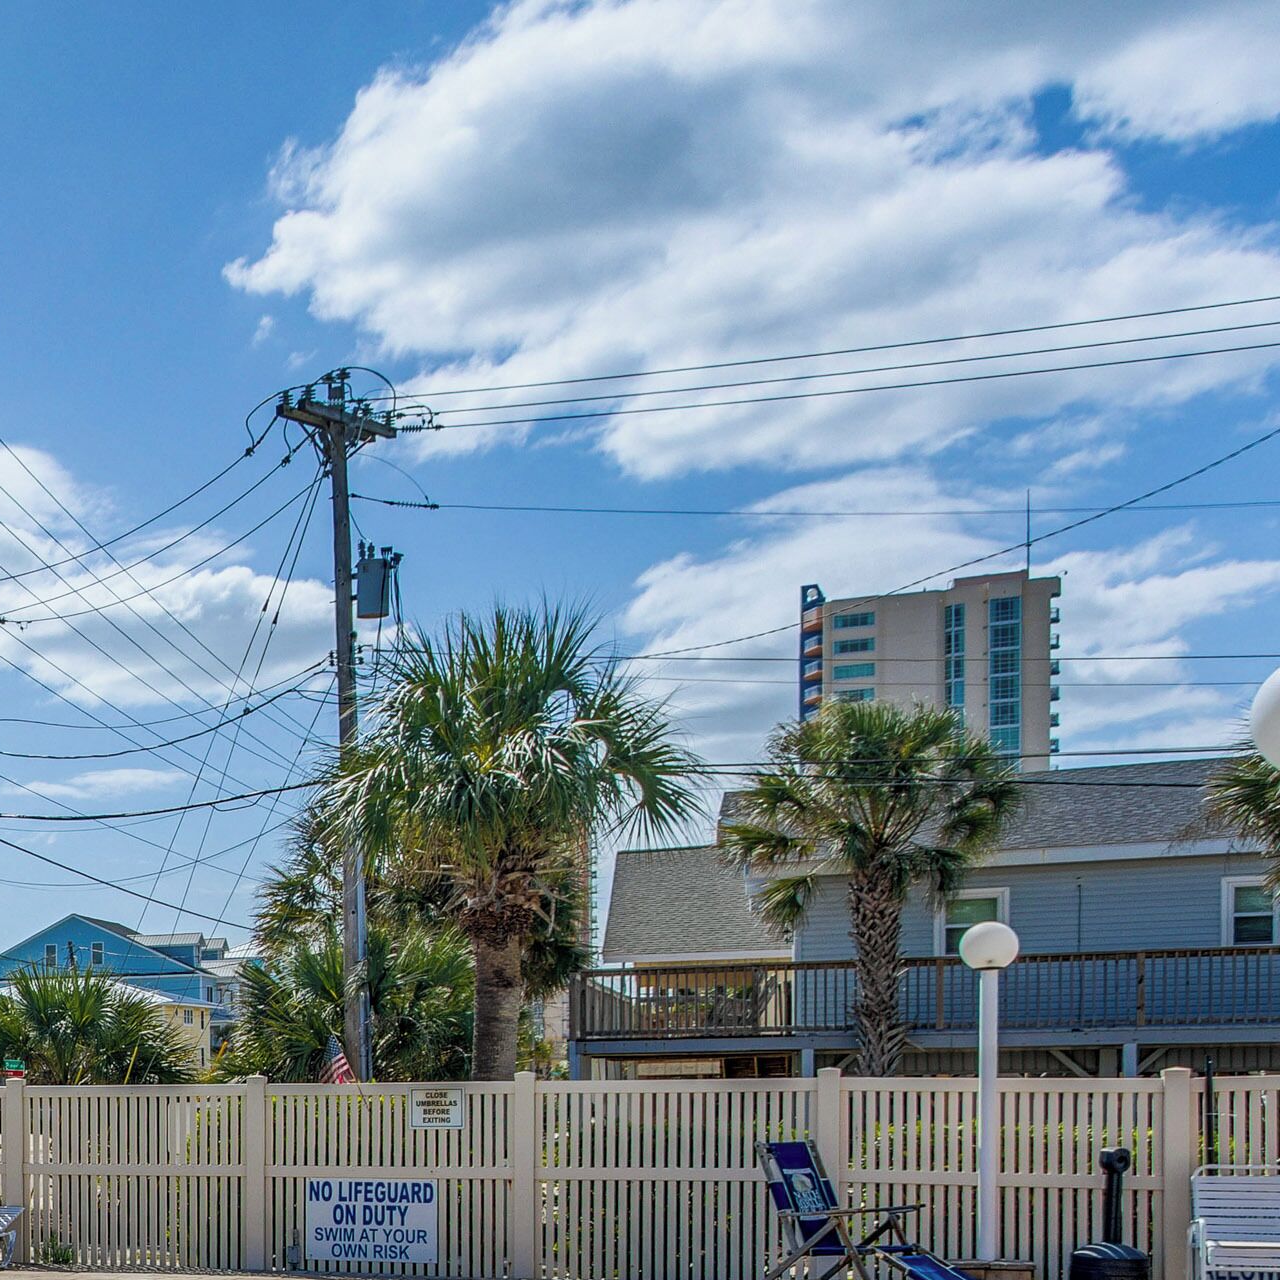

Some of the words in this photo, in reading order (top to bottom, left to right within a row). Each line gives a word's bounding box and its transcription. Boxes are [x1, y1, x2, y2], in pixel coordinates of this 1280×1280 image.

[309, 1181, 332, 1202] NO
[338, 1181, 434, 1203] LIFEGUARD
[333, 1204, 356, 1225] ON
[363, 1204, 408, 1226] DUTY
[314, 1227, 355, 1242] SWIM
[359, 1228, 378, 1242] AT
[382, 1229, 427, 1244] YOUR
[331, 1243, 367, 1258] OWN
[373, 1244, 409, 1260] RISK
